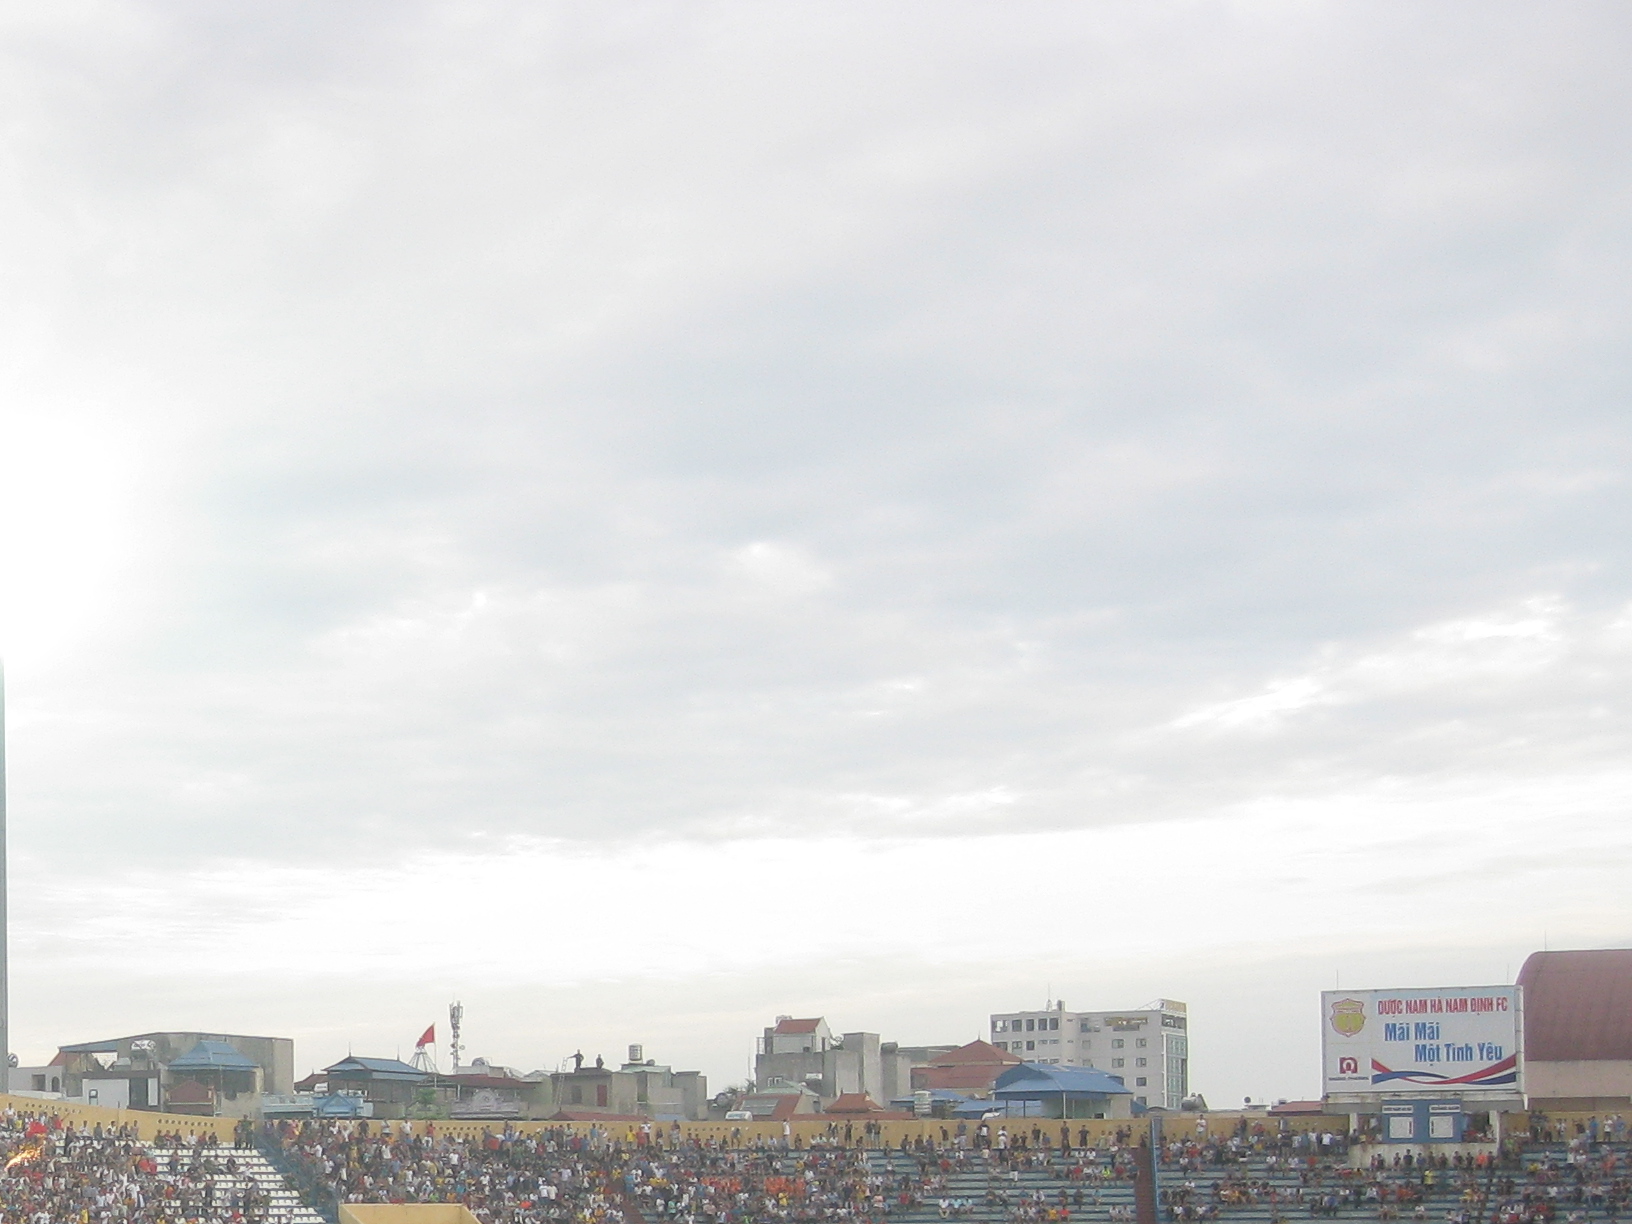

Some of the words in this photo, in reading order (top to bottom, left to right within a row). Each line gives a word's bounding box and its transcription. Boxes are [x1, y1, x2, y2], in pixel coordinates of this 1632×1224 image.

[1377, 1000, 1402, 1018] DƯỢC
[1405, 999, 1428, 1014] NAM
[1430, 996, 1443, 1013] HÀ
[1446, 998, 1468, 1014] NAM
[1470, 998, 1493, 1015] ĐỊNH
[1496, 997, 1508, 1012] FC
[1384, 1022, 1410, 1041] Mãi
[1414, 1021, 1440, 1041] Mãi
[1414, 1044, 1441, 1066] Một
[1444, 1043, 1473, 1062] Tình
[1477, 1042, 1502, 1061] Yêu
